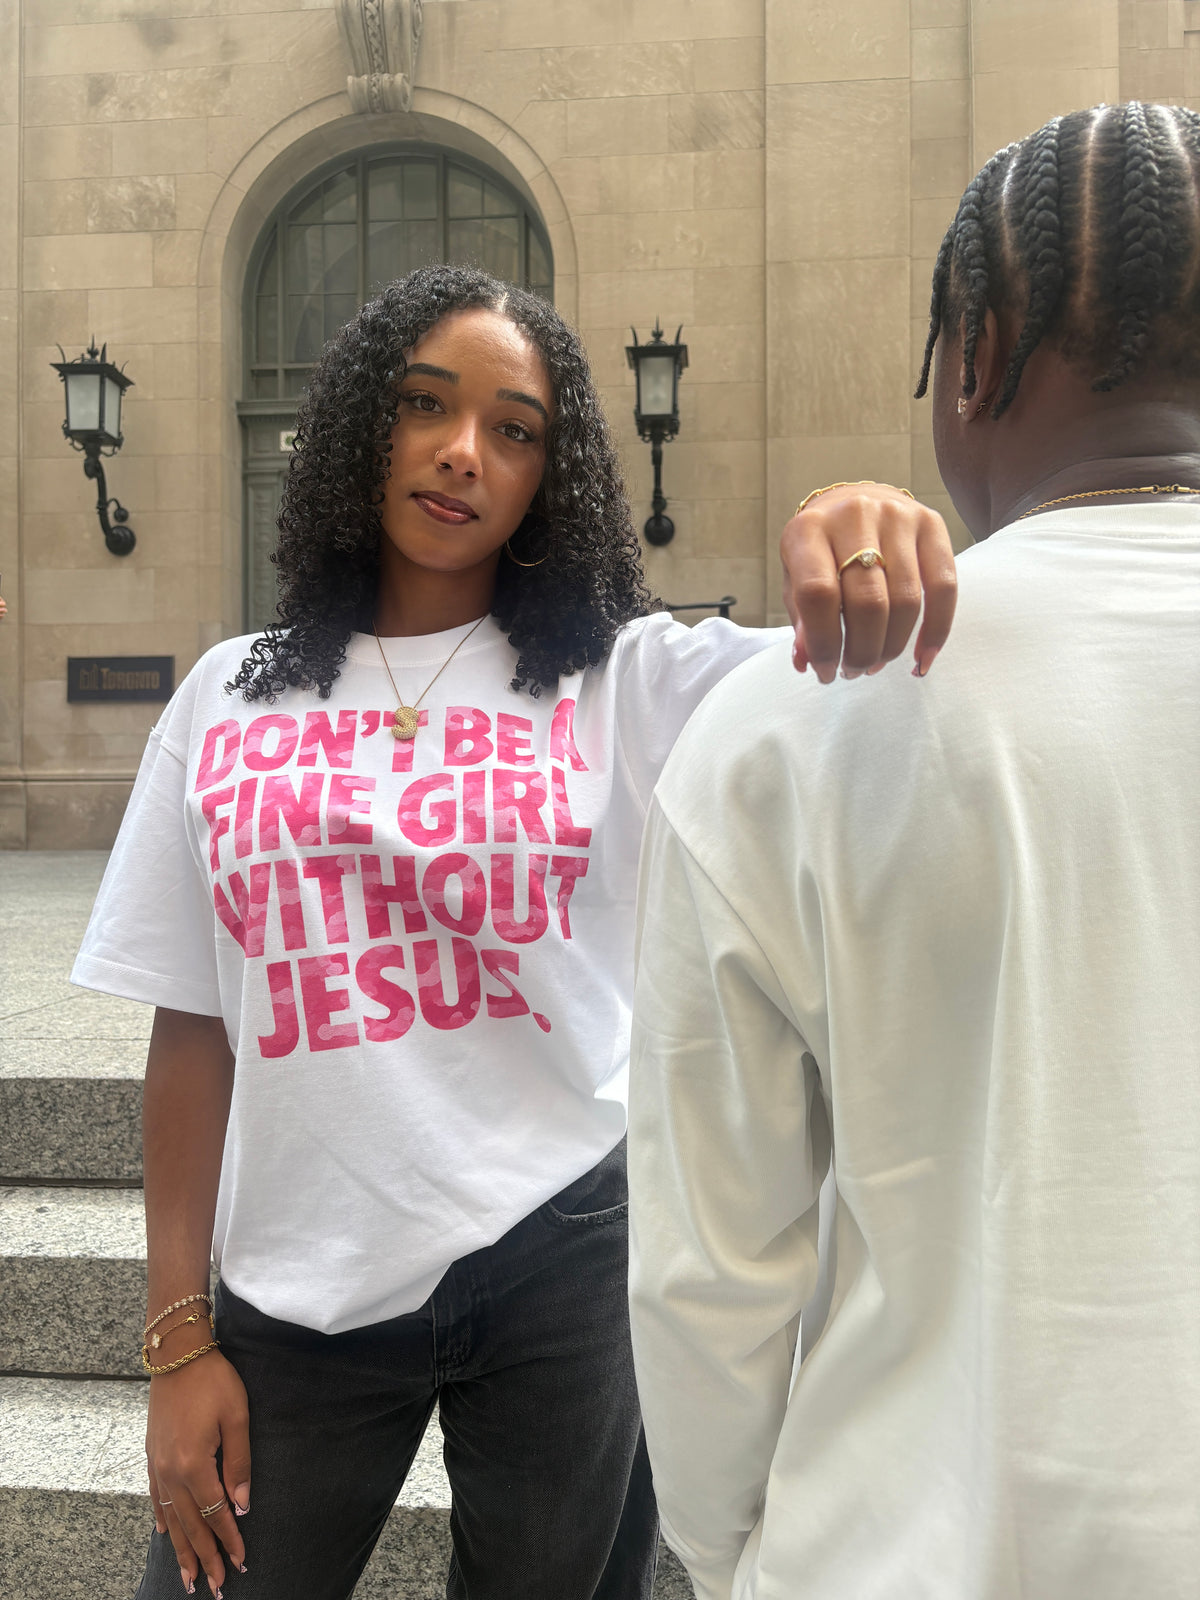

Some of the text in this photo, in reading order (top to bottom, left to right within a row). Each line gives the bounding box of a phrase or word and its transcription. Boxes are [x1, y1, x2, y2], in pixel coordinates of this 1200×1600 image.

[443, 706, 536, 767] BE
[549, 697, 590, 772] A
[201, 768, 593, 874] FINE GIRL
[213, 852, 590, 959] WITHOUT
[257, 936, 552, 1059] JESUS.
